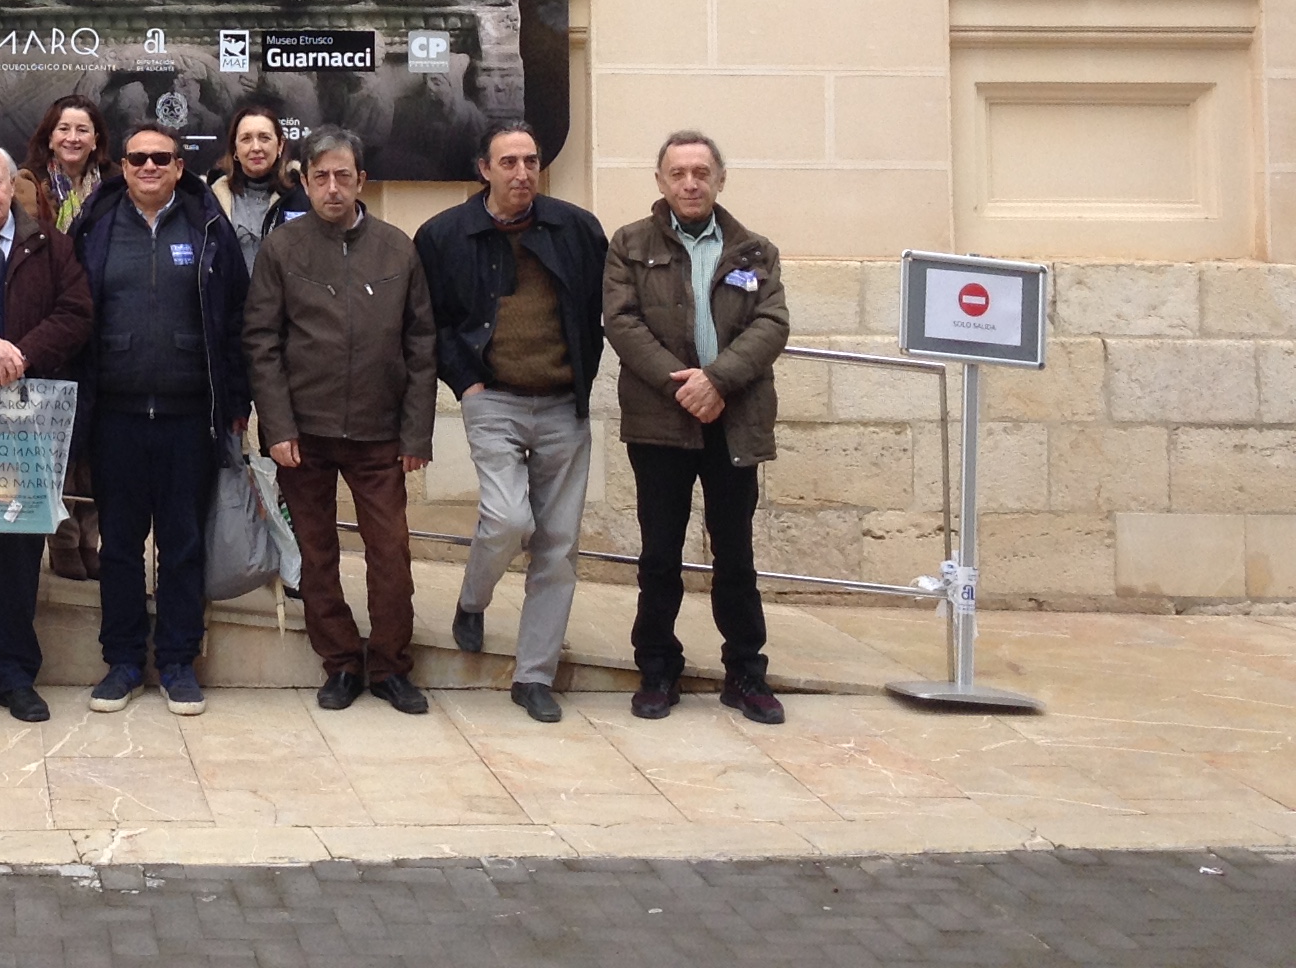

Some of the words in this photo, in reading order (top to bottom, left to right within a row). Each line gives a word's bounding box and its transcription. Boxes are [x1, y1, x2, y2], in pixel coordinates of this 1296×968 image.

[266, 35, 297, 45] Museo
[299, 35, 333, 45] Etrusco
[410, 36, 447, 58] CP
[267, 47, 371, 67] Guarnacci
[63, 63, 72, 71] DE
[75, 64, 116, 72] ALICANTE
[953, 320, 971, 329] SOLO
